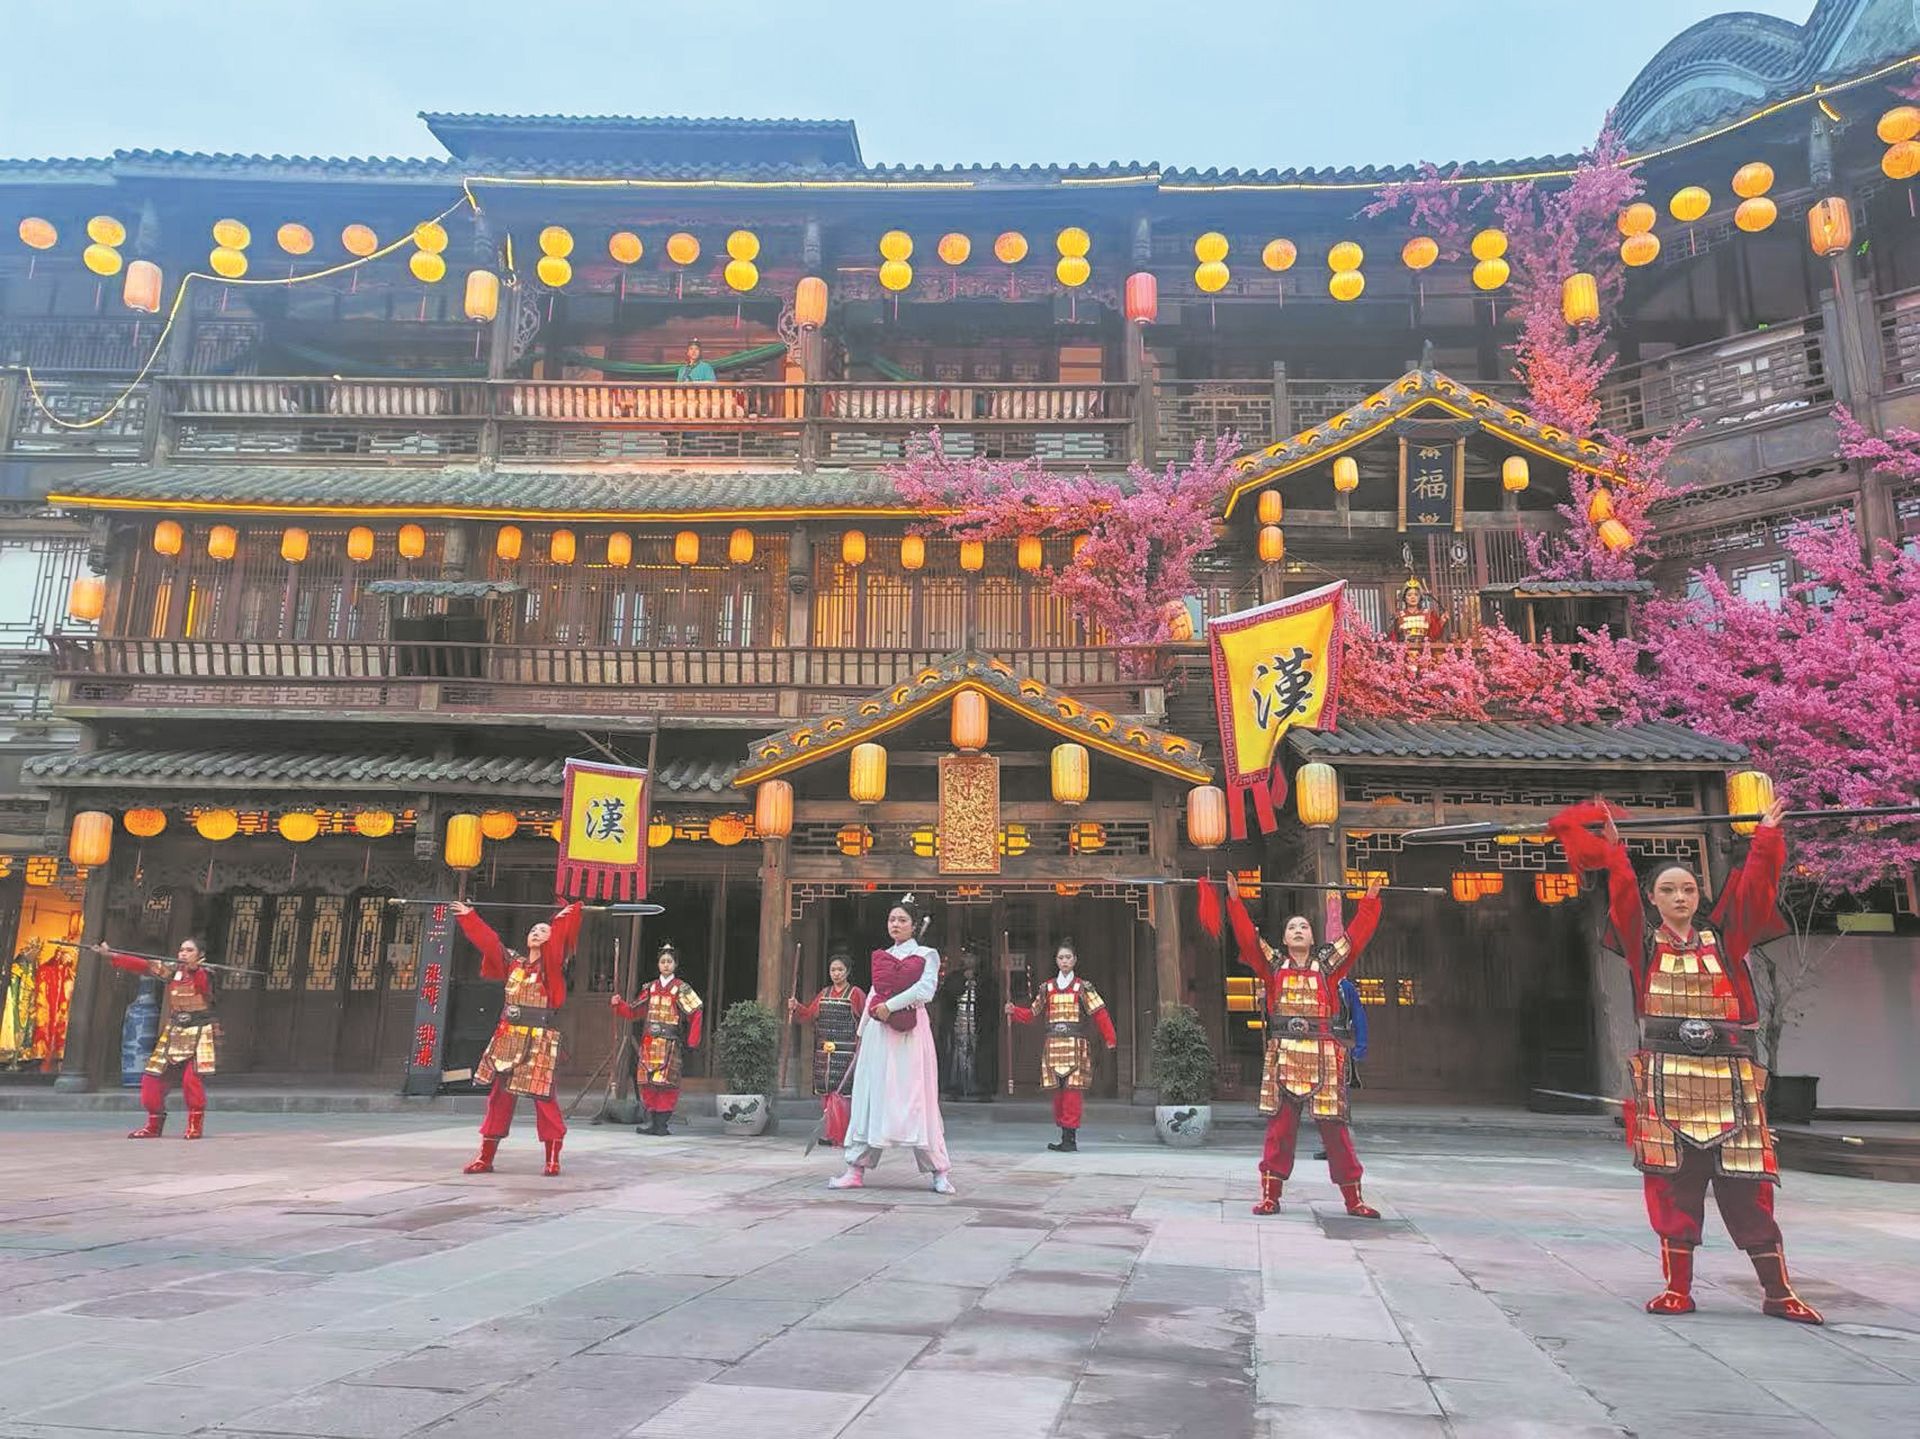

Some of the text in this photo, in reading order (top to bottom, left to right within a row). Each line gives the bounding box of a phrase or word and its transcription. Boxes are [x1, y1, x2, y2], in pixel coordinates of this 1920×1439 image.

[1411, 468, 1448, 500] 福
[1252, 646, 1313, 730] 漢
[585, 797, 625, 844] 漢
